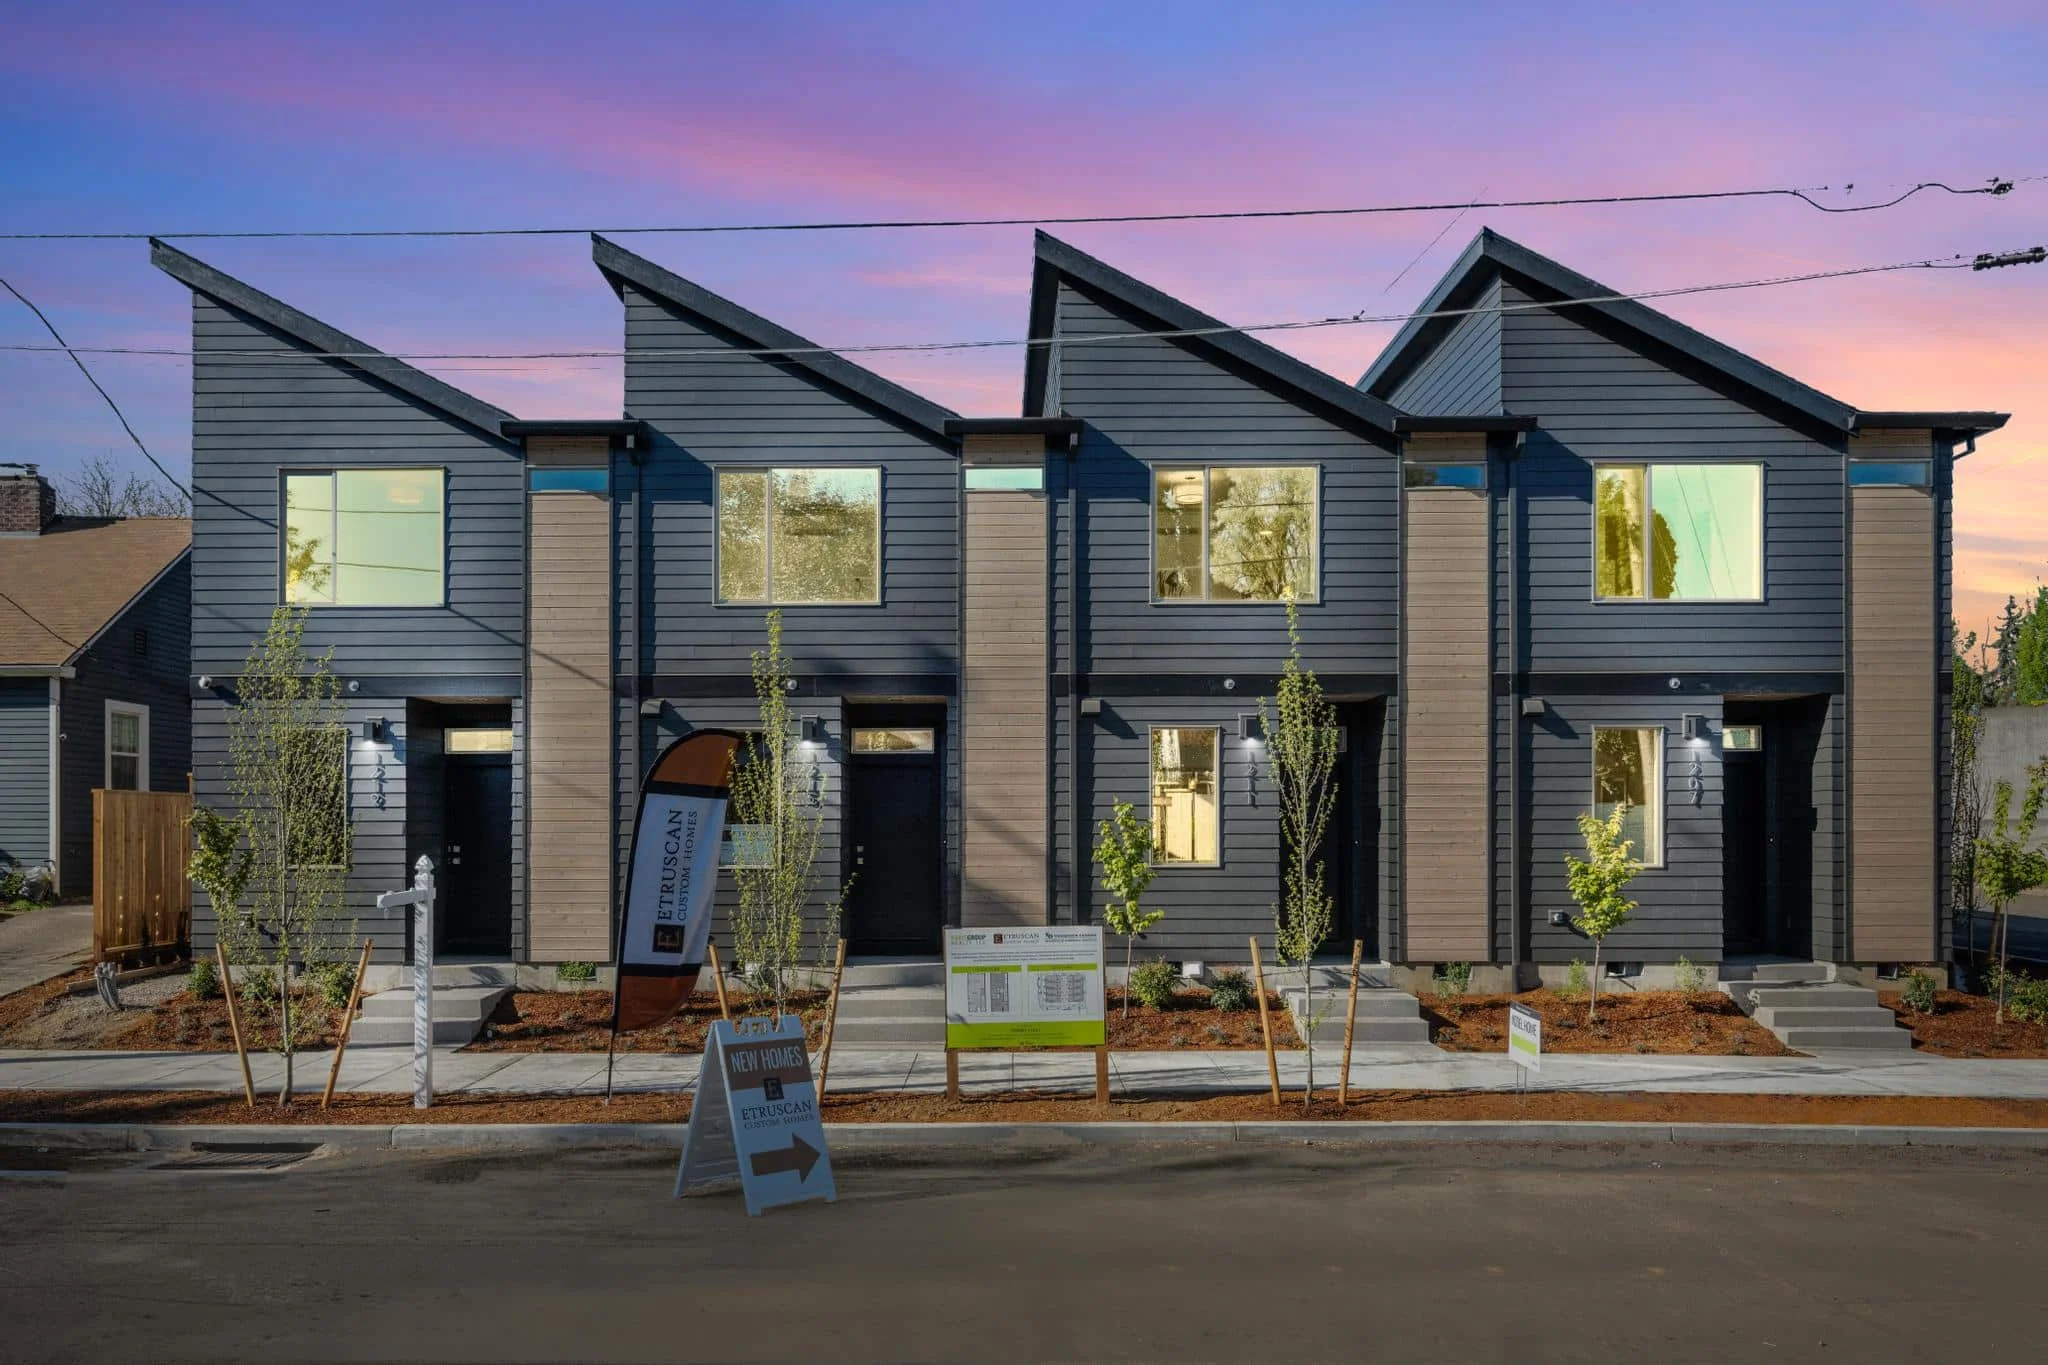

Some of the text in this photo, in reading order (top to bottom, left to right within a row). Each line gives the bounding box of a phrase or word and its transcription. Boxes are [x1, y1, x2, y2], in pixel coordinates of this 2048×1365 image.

[684, 810, 698, 860] HOMES
[657, 809, 683, 921] ETRUSCAN
[677, 867, 691, 921] CUSTOM
[730, 1045, 803, 1073] NEW HOMES
[742, 1100, 812, 1121] ETRUSCAN
